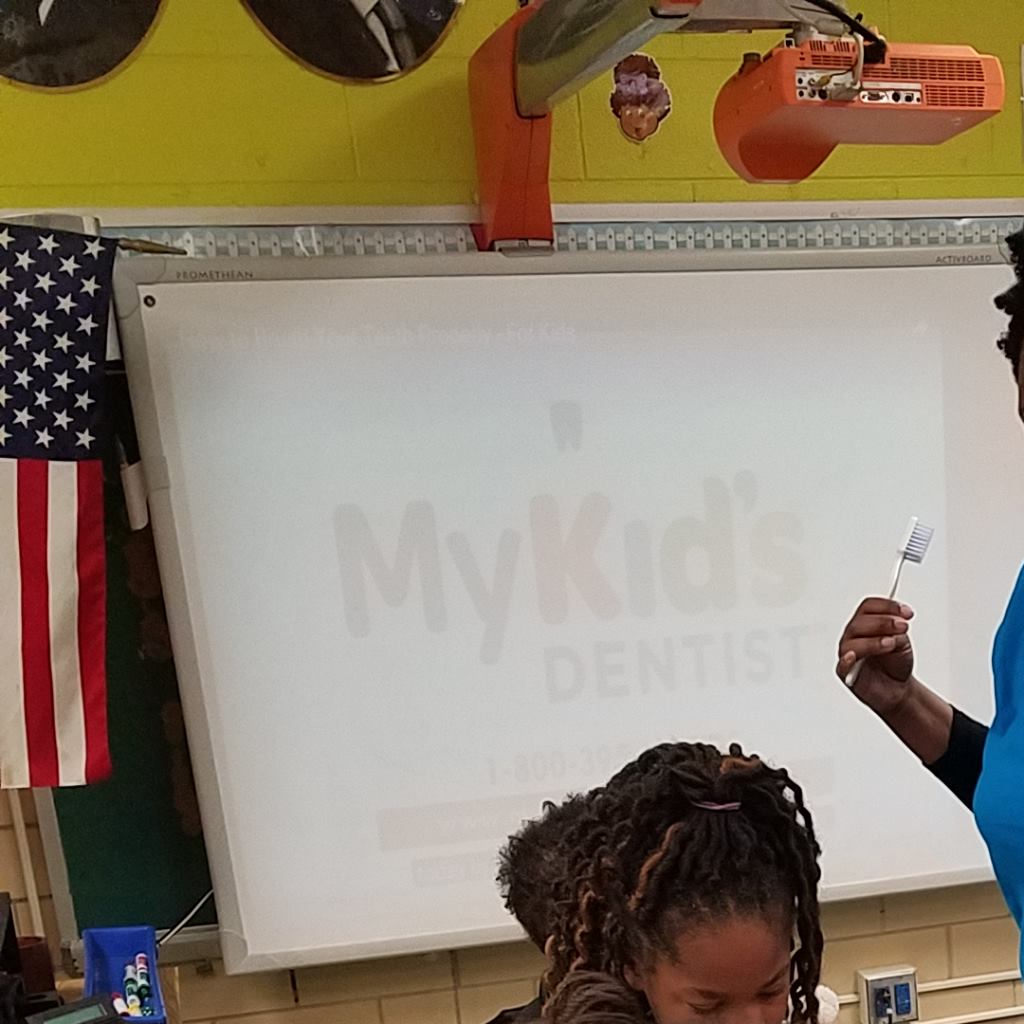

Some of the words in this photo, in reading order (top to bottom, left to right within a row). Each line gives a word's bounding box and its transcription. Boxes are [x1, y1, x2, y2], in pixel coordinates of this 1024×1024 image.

[176, 271, 254, 280] PROMETHEAN
[333, 469, 808, 666] MyKid's
[543, 624, 812, 704] DENTIST
